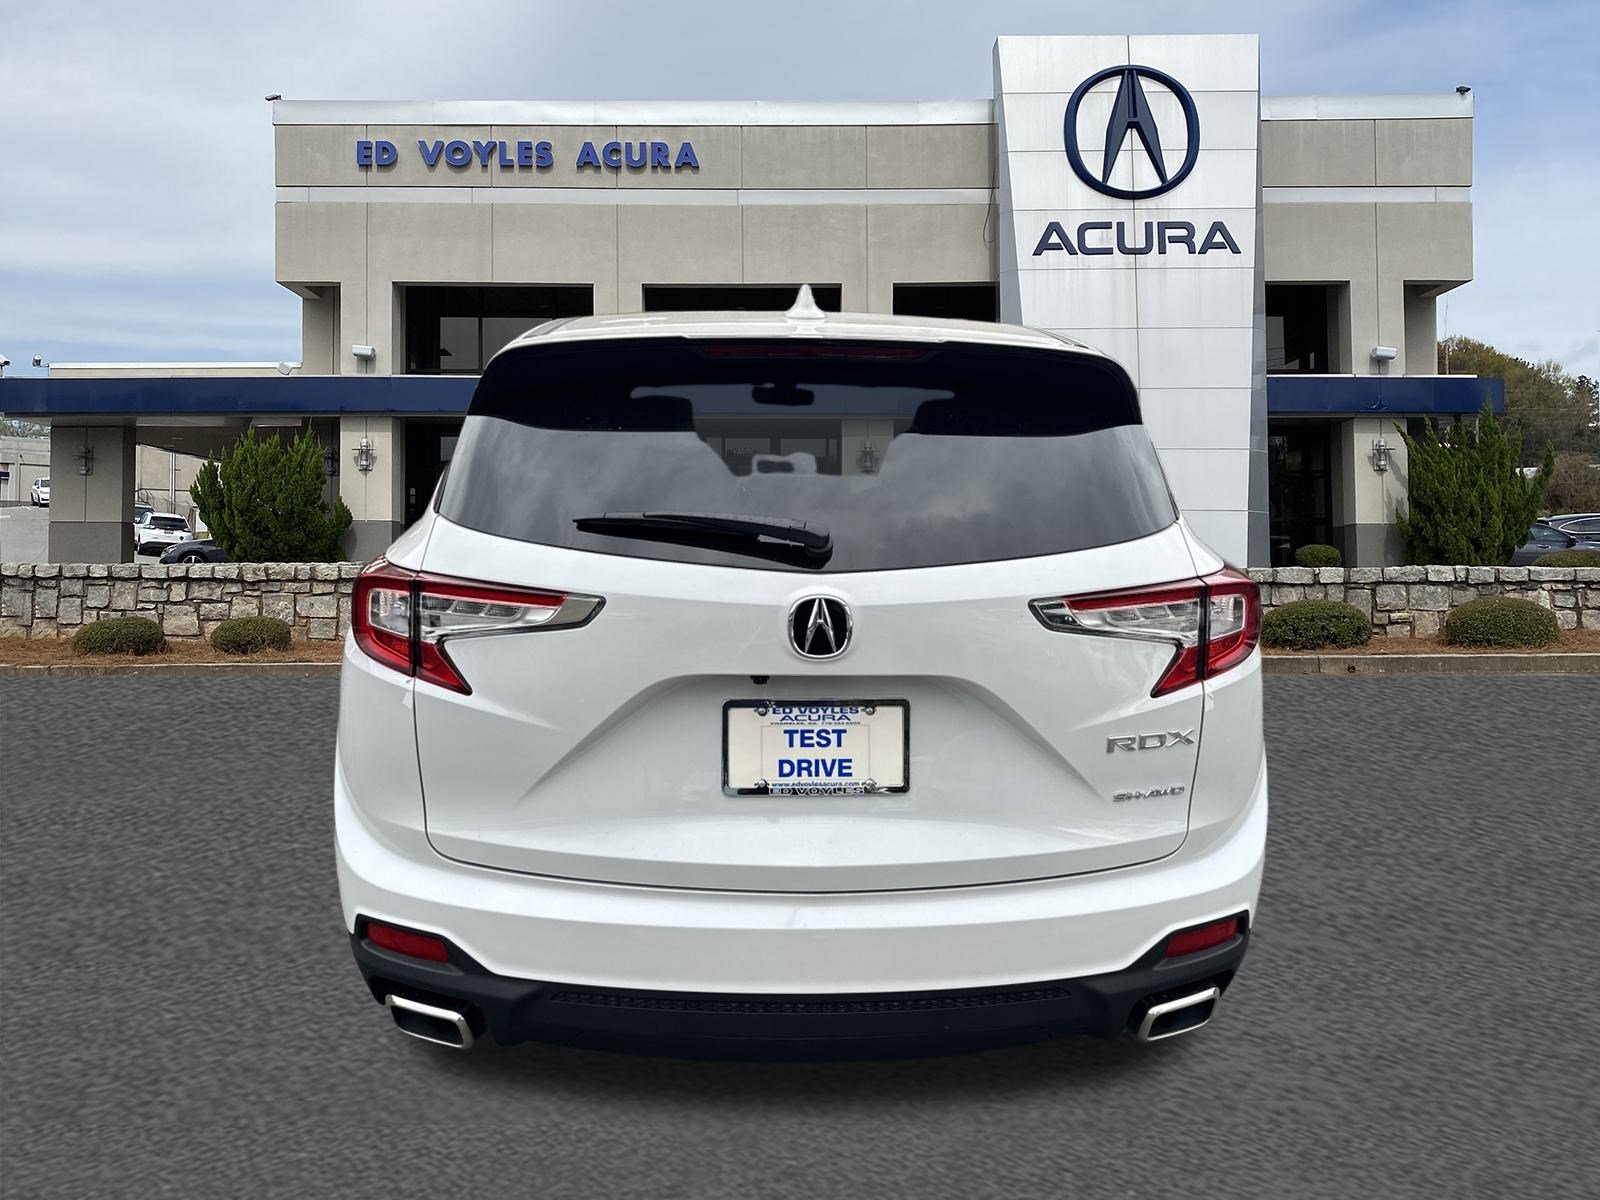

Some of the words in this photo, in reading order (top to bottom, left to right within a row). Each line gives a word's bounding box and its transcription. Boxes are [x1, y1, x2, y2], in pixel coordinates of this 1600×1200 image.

[355, 139, 398, 169] ED
[417, 139, 555, 169] VOYLES
[575, 140, 701, 169] ACURA
[1031, 220, 1243, 256] ACURA
[772, 706, 793, 715] ED
[798, 706, 860, 715] VOYLES
[780, 714, 852, 722] ACURA
[783, 728, 848, 748] TEST
[1105, 728, 1195, 754] RDX
[778, 758, 853, 778] DRIVE
[769, 787, 793, 796] ED
[797, 787, 865, 796] VOYLES
[771, 780, 861, 788] www.edvoylesacura.com
